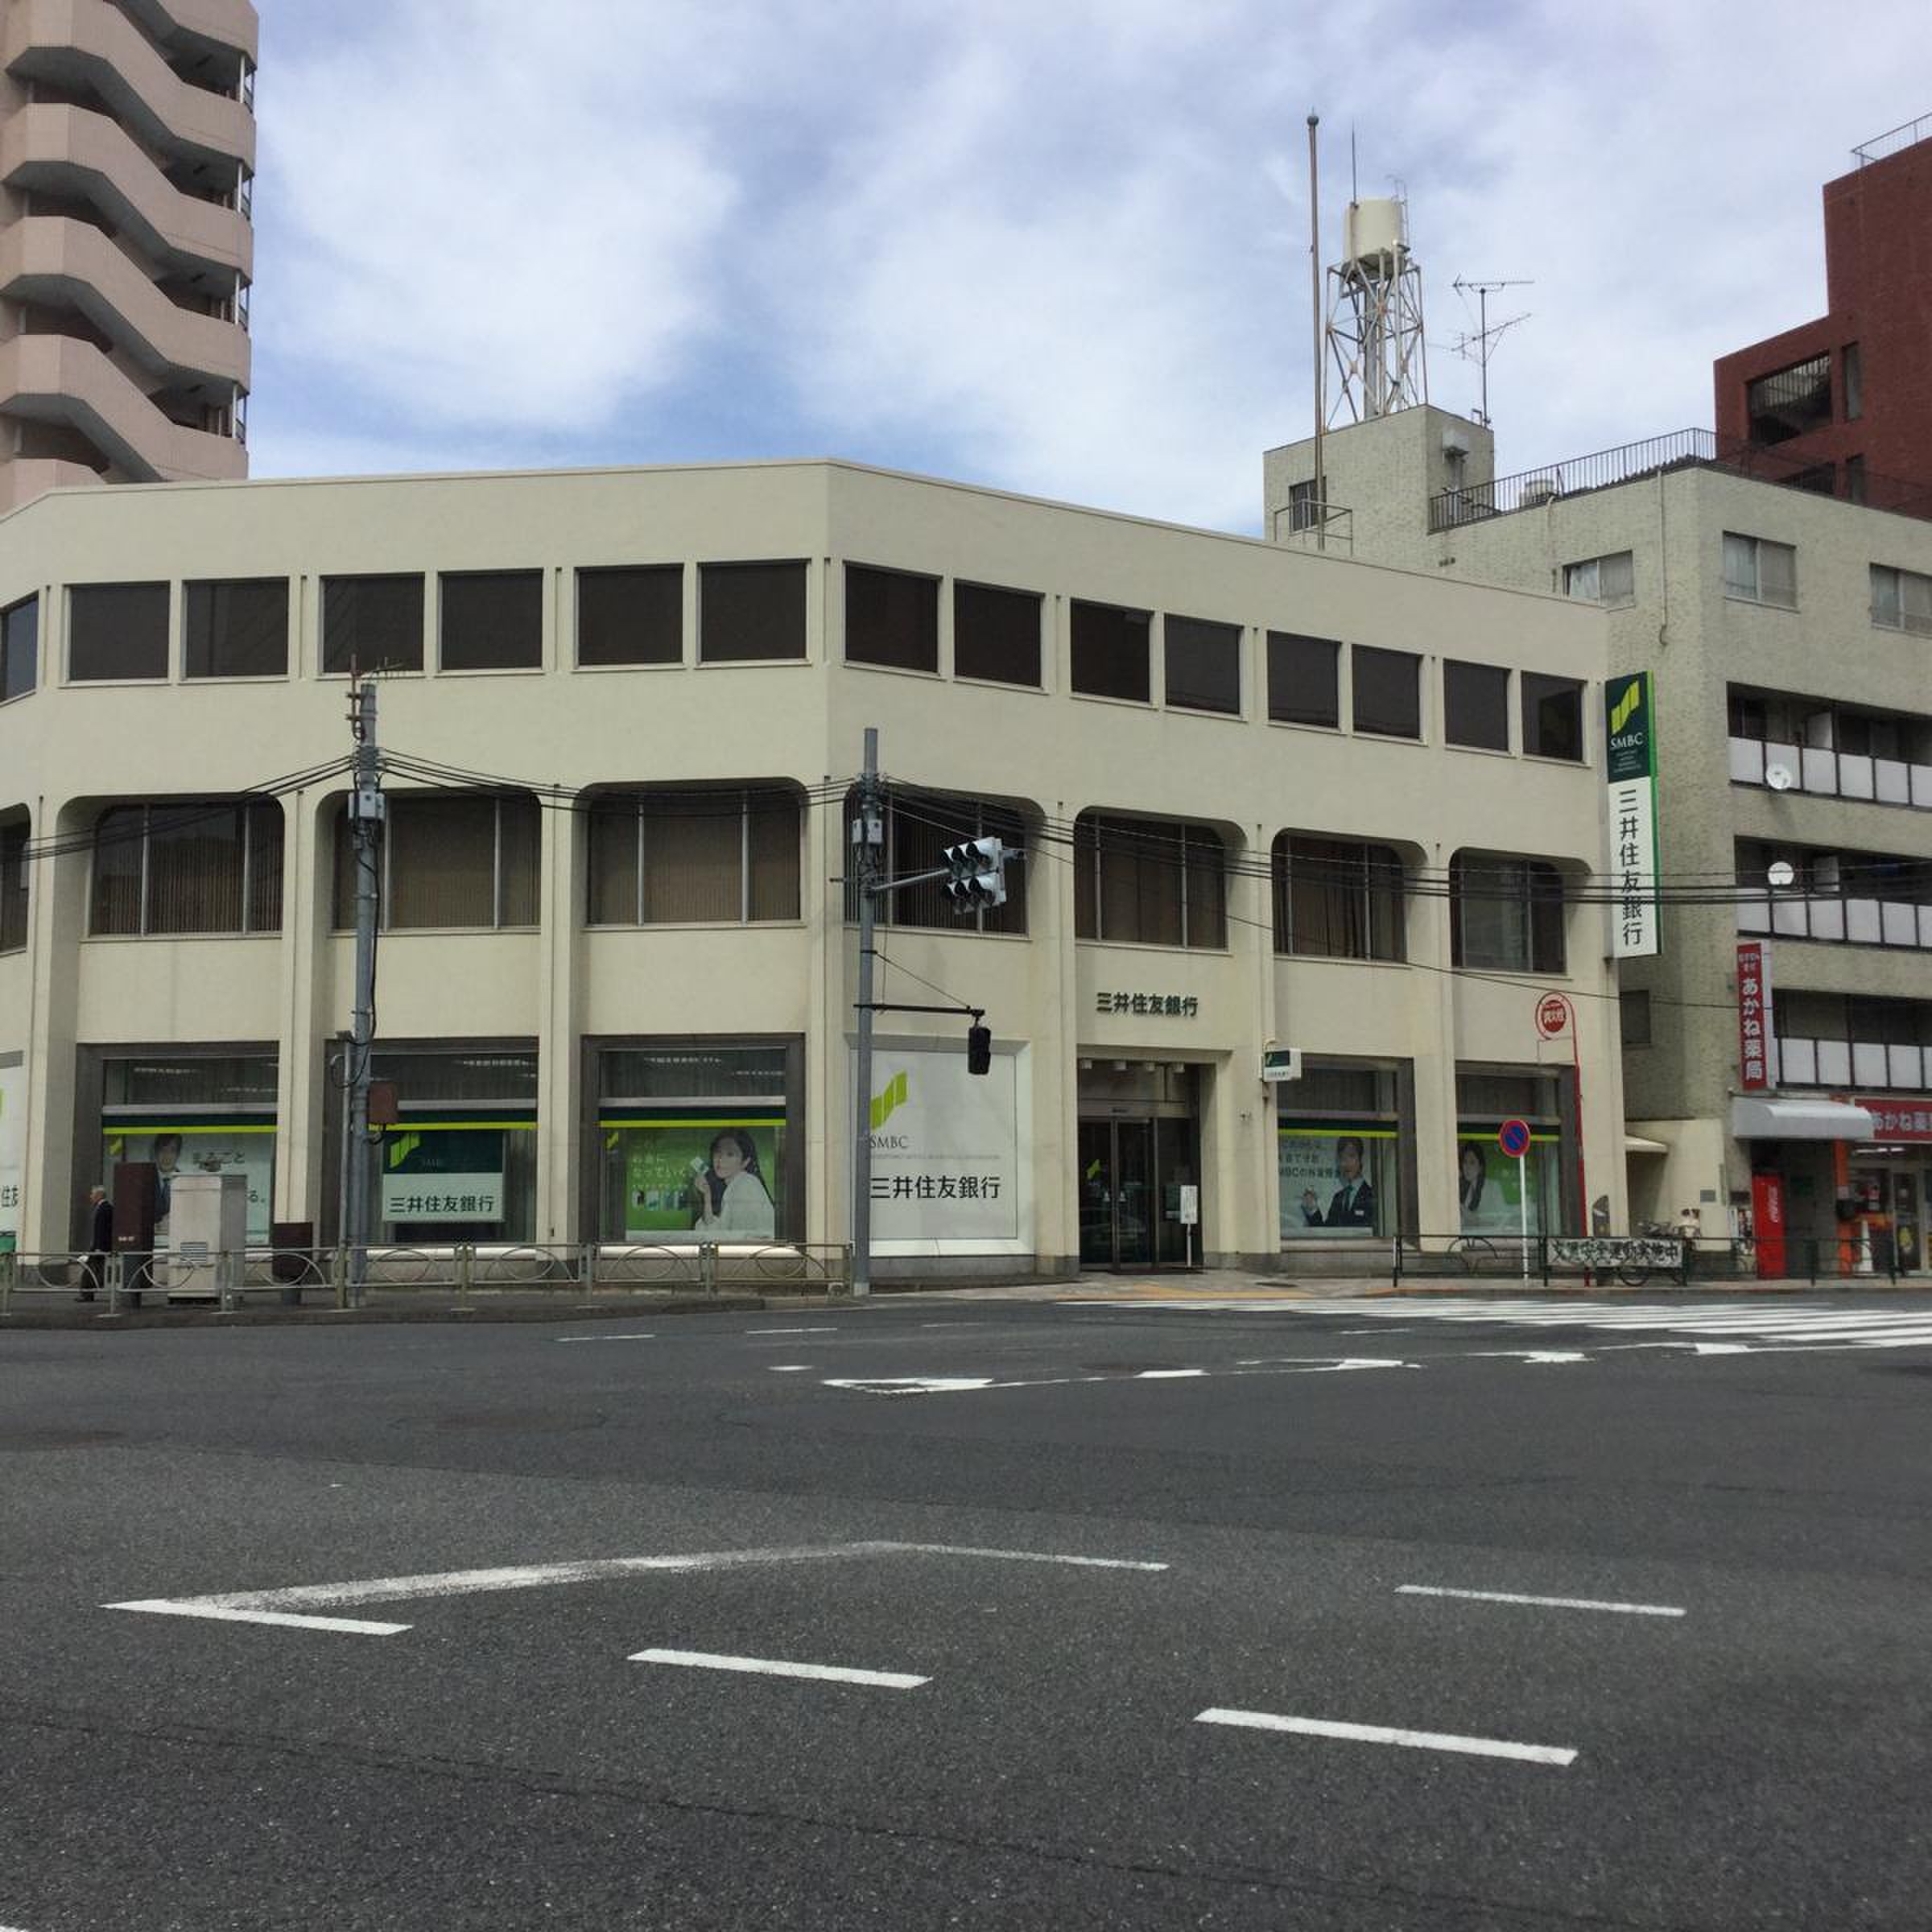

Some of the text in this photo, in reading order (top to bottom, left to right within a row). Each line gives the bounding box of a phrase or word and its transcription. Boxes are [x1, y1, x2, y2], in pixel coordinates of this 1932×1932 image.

[1610, 732, 1644, 749] SMBC
[1619, 789, 1643, 947] 三井住友銀行
[1096, 992, 1199, 1018] 三井住友銀行
[1742, 977, 1763, 1082] あかね薬局
[869, 1134, 909, 1150] SMBC
[870, 1175, 1001, 1199] 三井住友銀行
[390, 1195, 495, 1213] 三井住友銀行
[1552, 1238, 1678, 1262] 交通安全運動実施中
